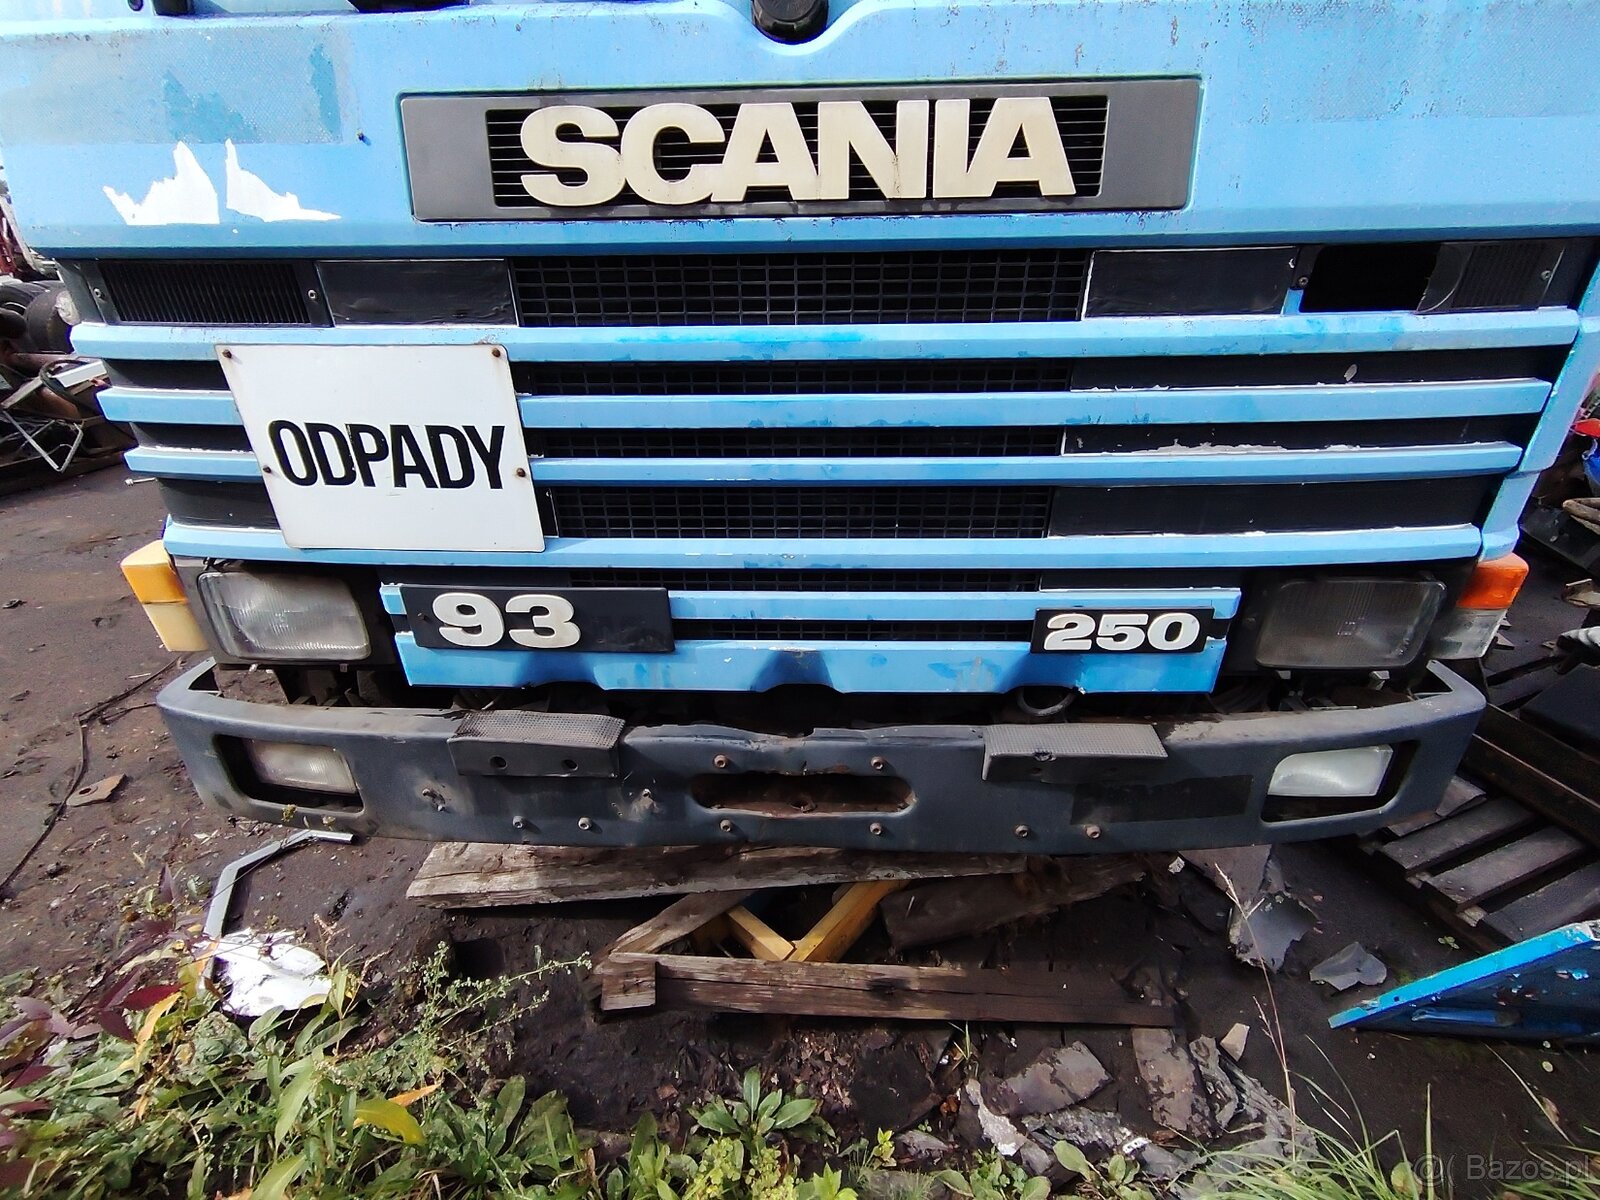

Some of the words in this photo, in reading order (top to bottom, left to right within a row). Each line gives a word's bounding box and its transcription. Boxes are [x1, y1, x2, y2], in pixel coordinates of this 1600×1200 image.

[520, 97, 1077, 206] SCANIA
[268, 420, 505, 490] ODPADY
[432, 592, 581, 648] 93
[1043, 612, 1200, 651] 250
